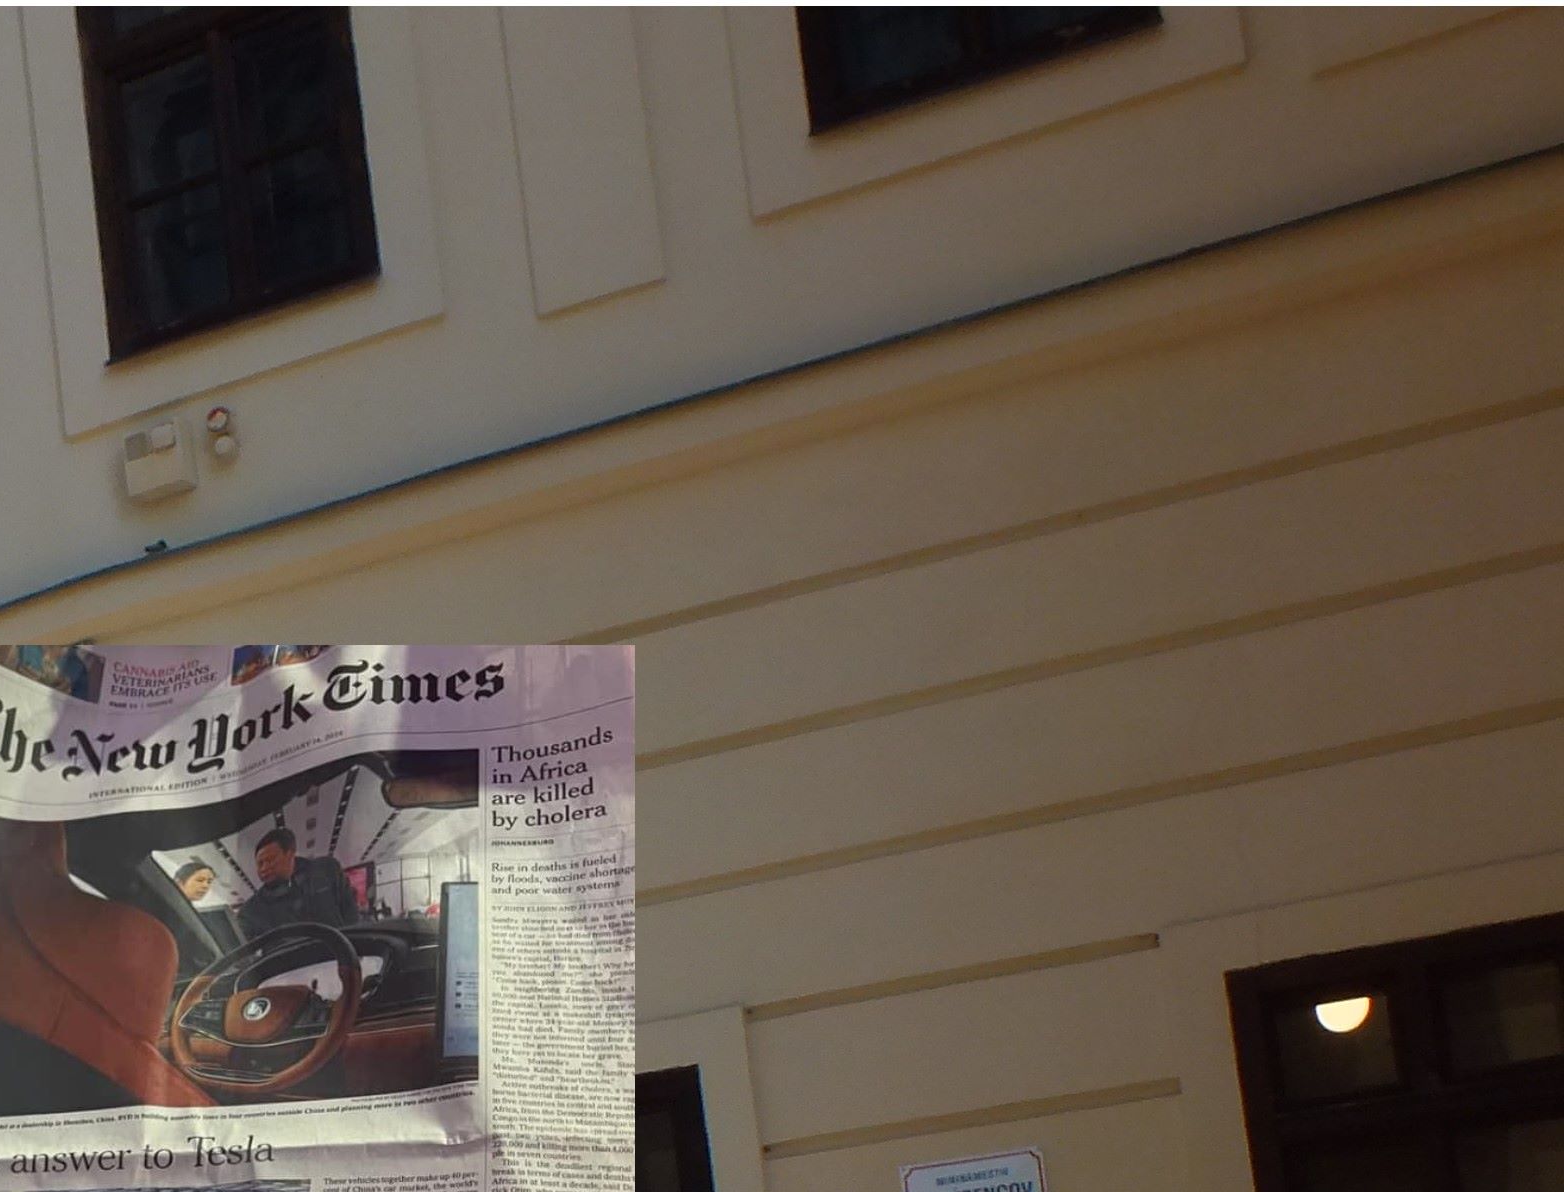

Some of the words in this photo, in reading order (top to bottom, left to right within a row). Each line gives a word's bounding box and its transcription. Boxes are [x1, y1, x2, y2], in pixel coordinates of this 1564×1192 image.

[112, 665, 211, 687] VETERINARIANS
[114, 661, 176, 677] CANNABIS
[110, 683, 170, 697] EMBRACE
[194, 673, 218, 686] USE
[61, 730, 178, 782] New
[186, 684, 314, 774] York
[322, 659, 505, 711] Times
[491, 726, 614, 763] Thousands
[492, 769, 512, 784] in
[520, 760, 588, 783] Africa
[89, 784, 166, 799] INTERNATIONAL
[168, 777, 208, 791] EDITION
[491, 793, 526, 806] are
[534, 776, 594, 804] killed
[492, 811, 517, 831] by
[525, 805, 607, 827] cholera
[491, 862, 515, 873] Rise
[518, 861, 529, 872] in
[531, 858, 567, 873] deaths
[570, 857, 580, 869] is
[582, 853, 617, 868] fueled
[491, 873, 505, 885] by
[507, 872, 543, 885] floods,
[546, 871, 586, 882] vaccine
[491, 885, 512, 895] and
[515, 886, 539, 897] poor
[542, 884, 572, 895] water
[10, 1147, 133, 1175] answer
[142, 1142, 174, 1171] to
[186, 1134, 275, 1168] Tesla
